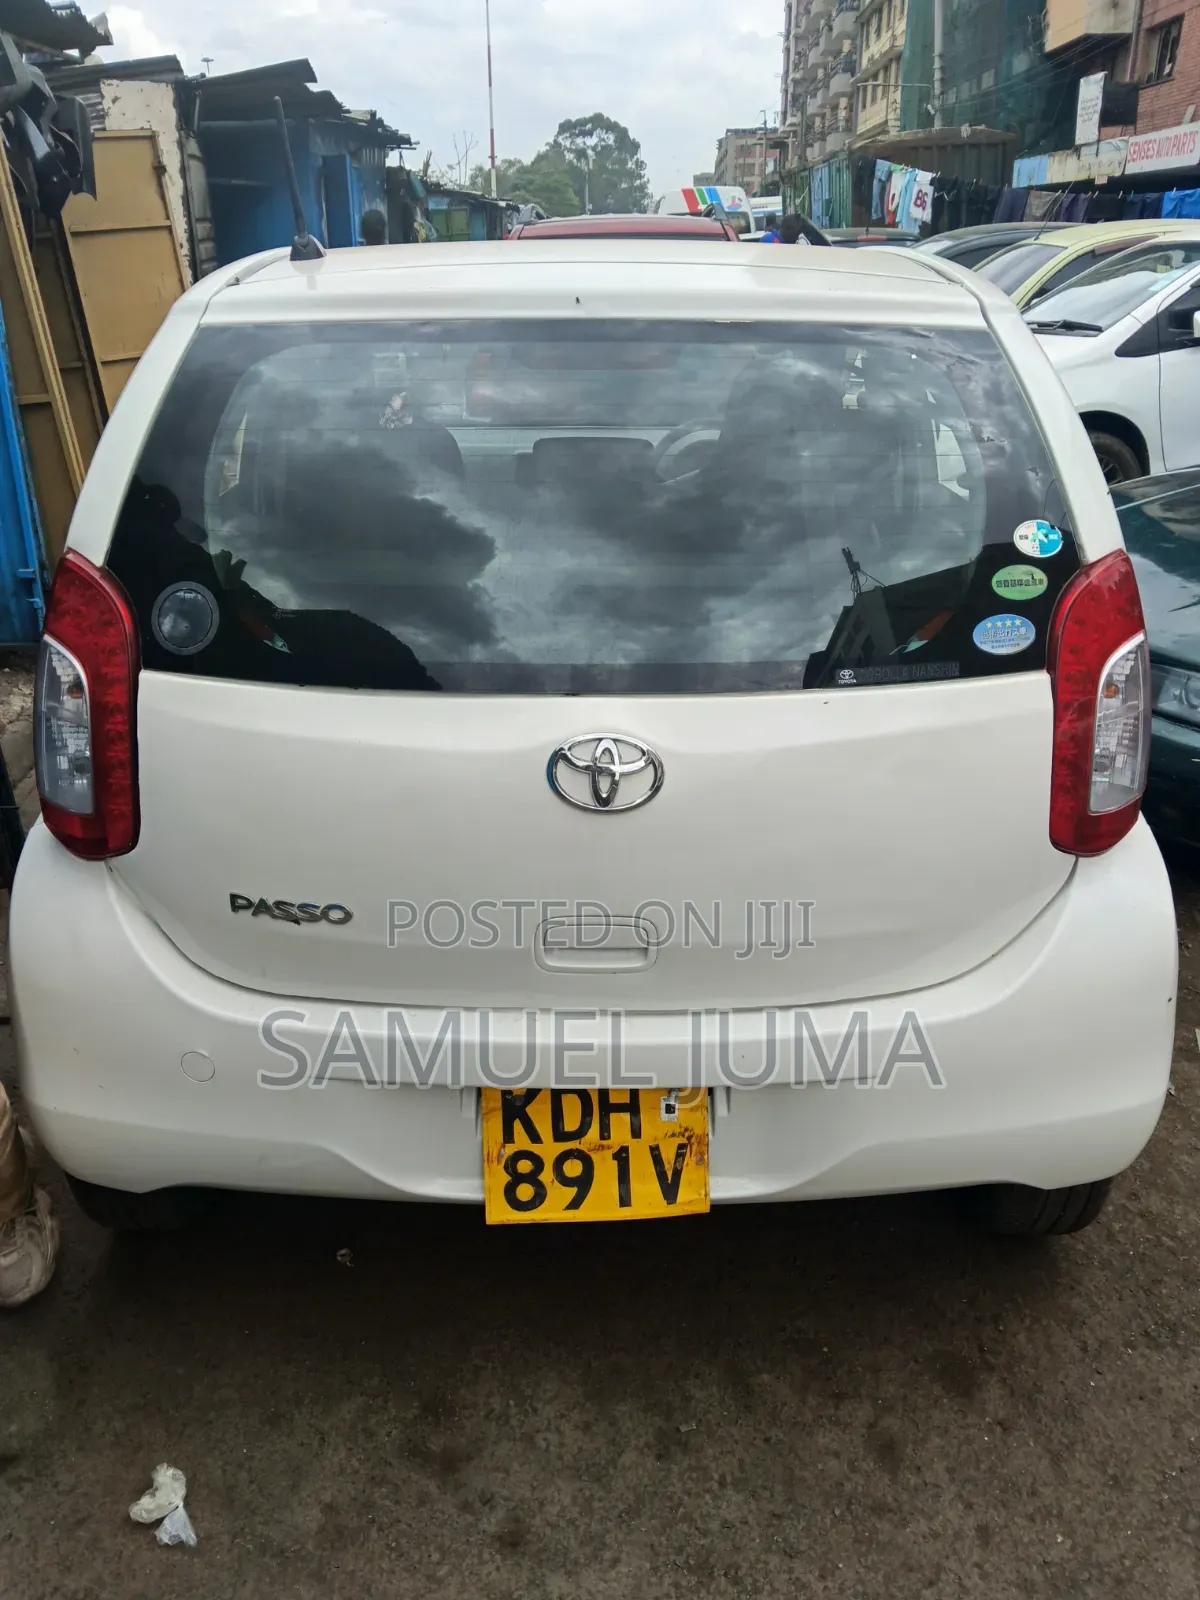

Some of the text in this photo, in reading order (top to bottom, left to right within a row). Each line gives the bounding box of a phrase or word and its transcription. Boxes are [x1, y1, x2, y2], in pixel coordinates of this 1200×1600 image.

[1127, 130, 1198, 164] SENSES AUTO PARTS
[229, 892, 354, 925] PASSO
[501, 1087, 642, 1145] KDH
[503, 1142, 689, 1212] 891V
